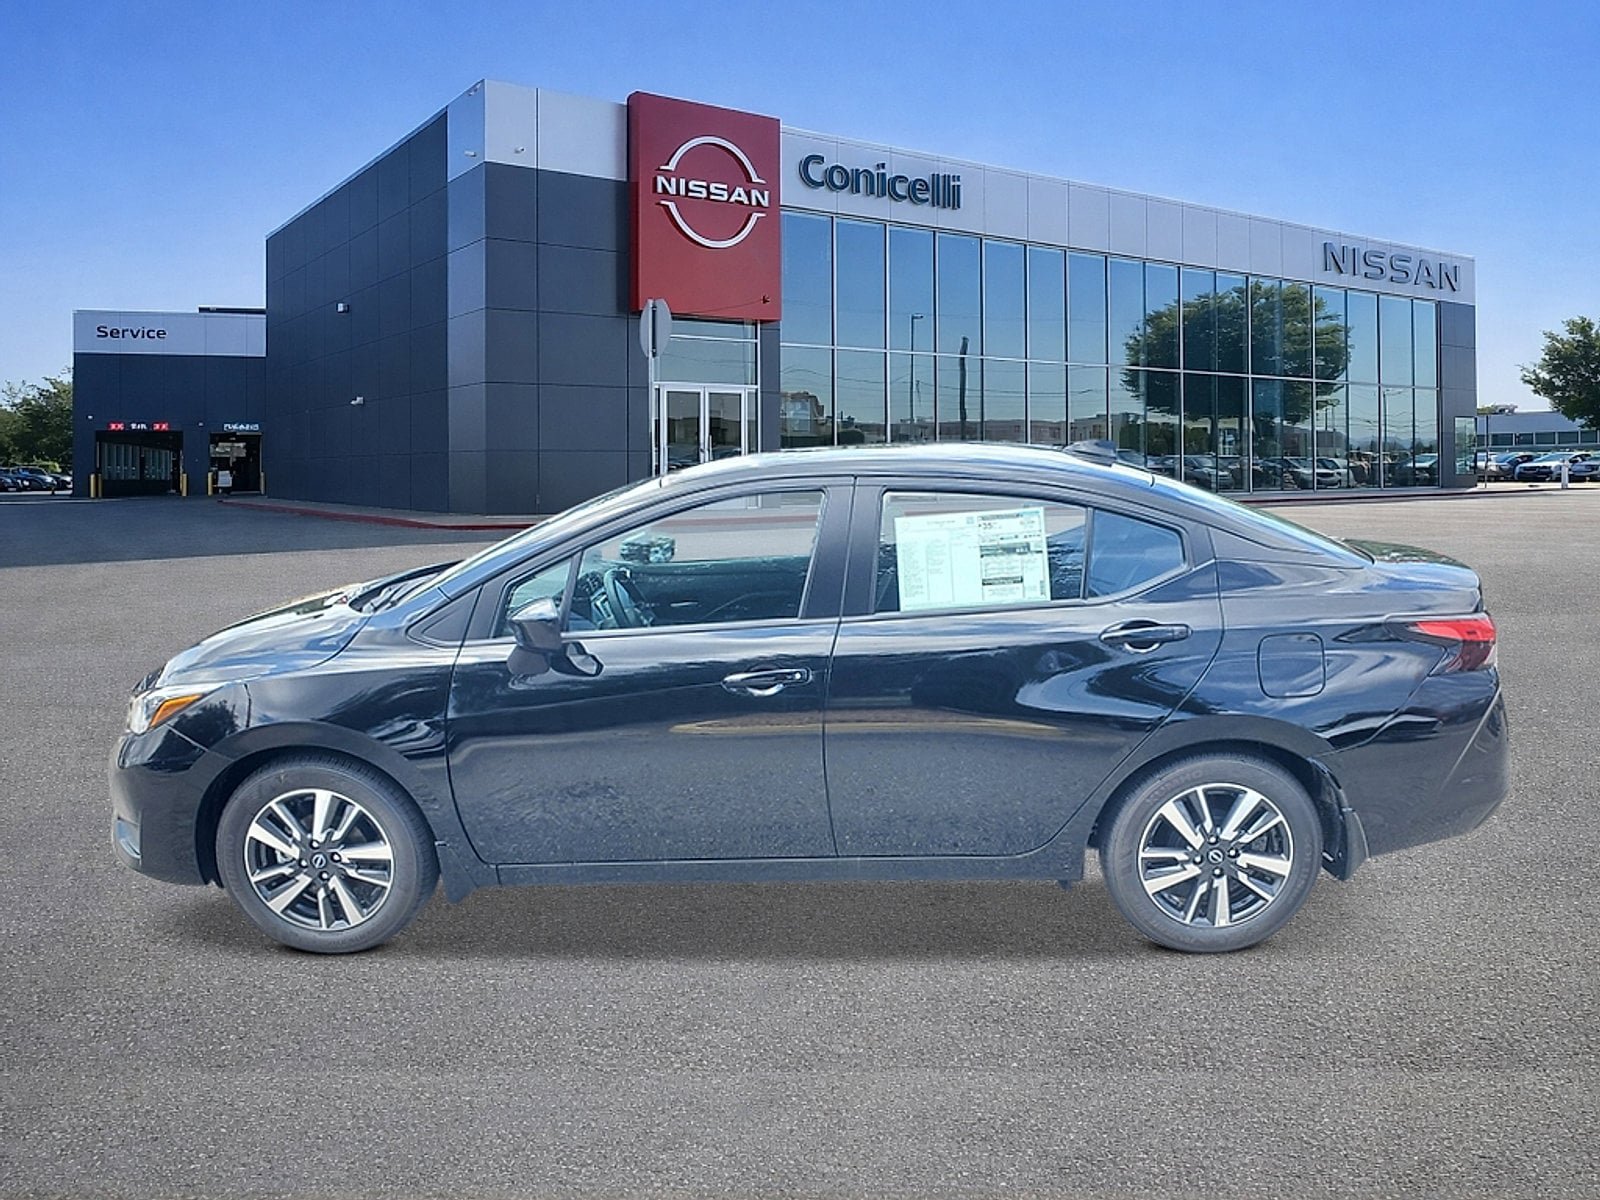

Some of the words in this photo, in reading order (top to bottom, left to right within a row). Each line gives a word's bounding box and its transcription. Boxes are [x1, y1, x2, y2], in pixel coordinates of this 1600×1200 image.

[656, 175, 769, 208] NISSAN
[800, 154, 961, 210] Conicelli
[1323, 241, 1461, 292] NISSAN
[96, 325, 167, 339] Service
